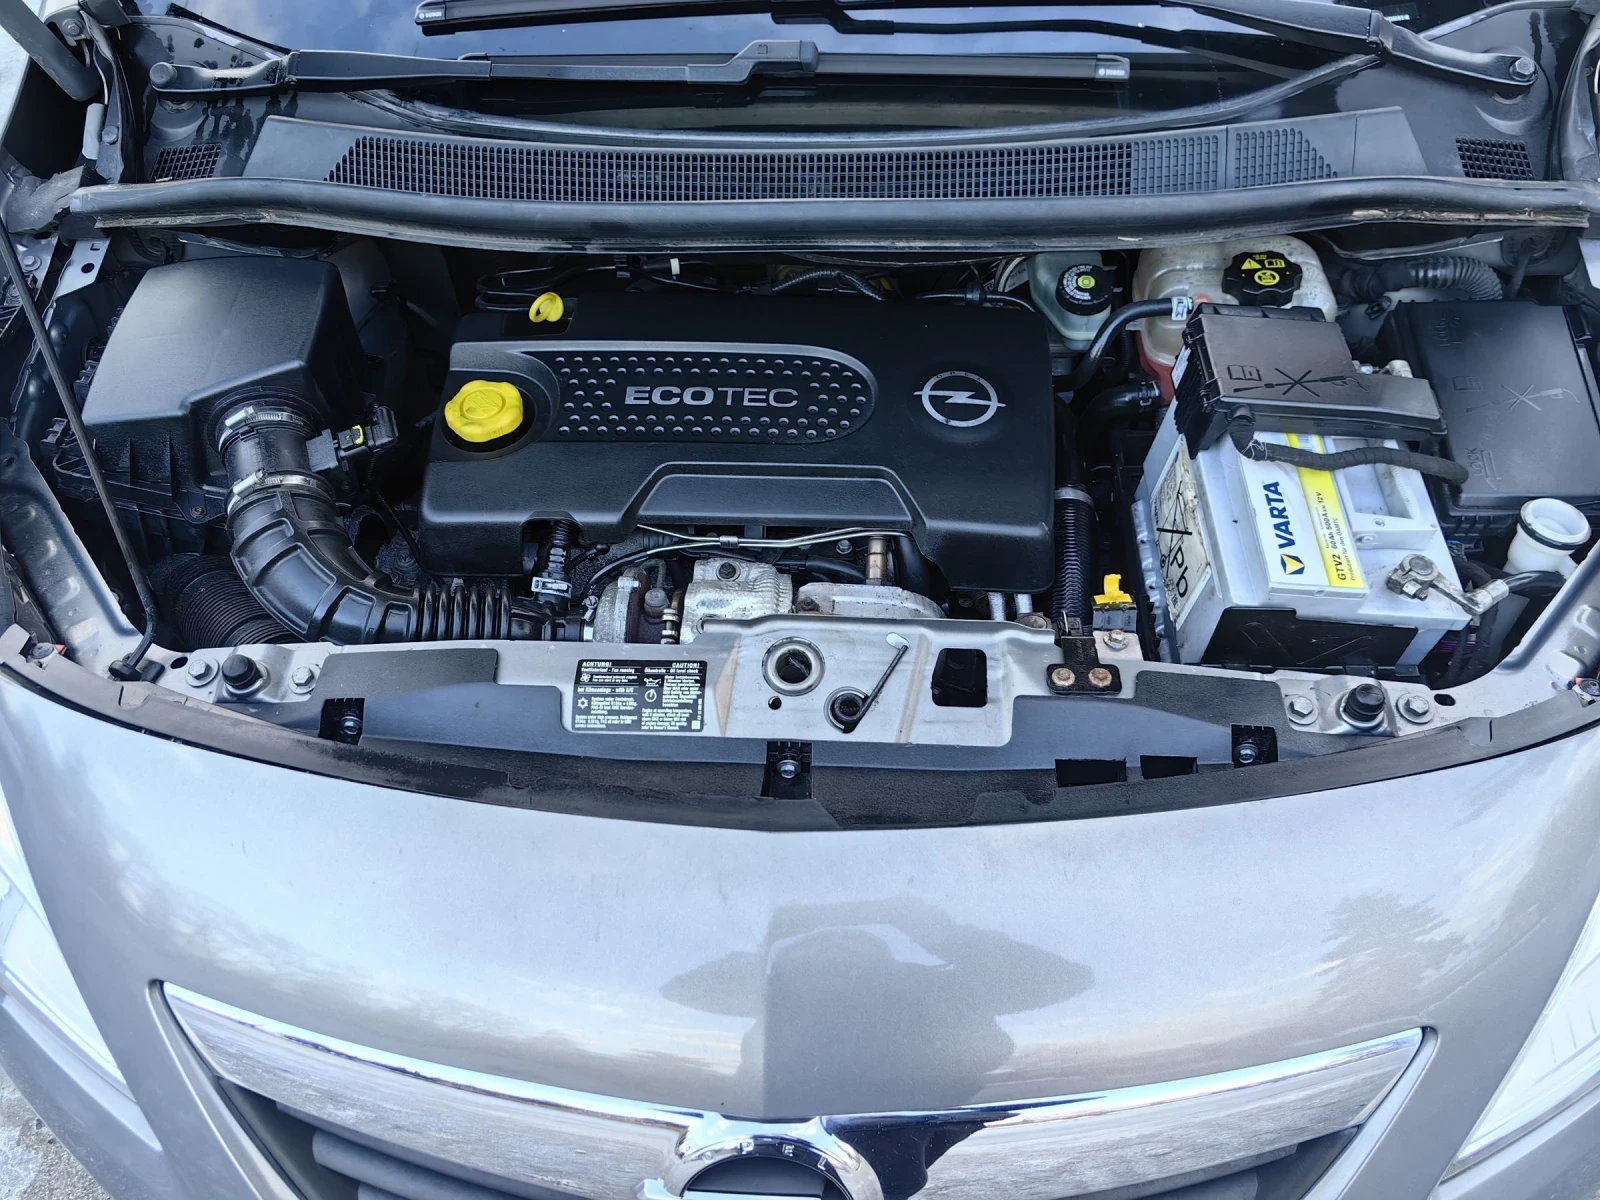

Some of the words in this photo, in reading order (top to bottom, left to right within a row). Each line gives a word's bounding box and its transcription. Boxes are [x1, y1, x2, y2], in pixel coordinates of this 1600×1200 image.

[624, 386, 798, 408] ECOTEC
[1465, 447, 1485, 477] LOCK
[1262, 481, 1296, 549] VARTA
[1170, 545, 1188, 598] Pb
[1332, 553, 1347, 581] GTV2
